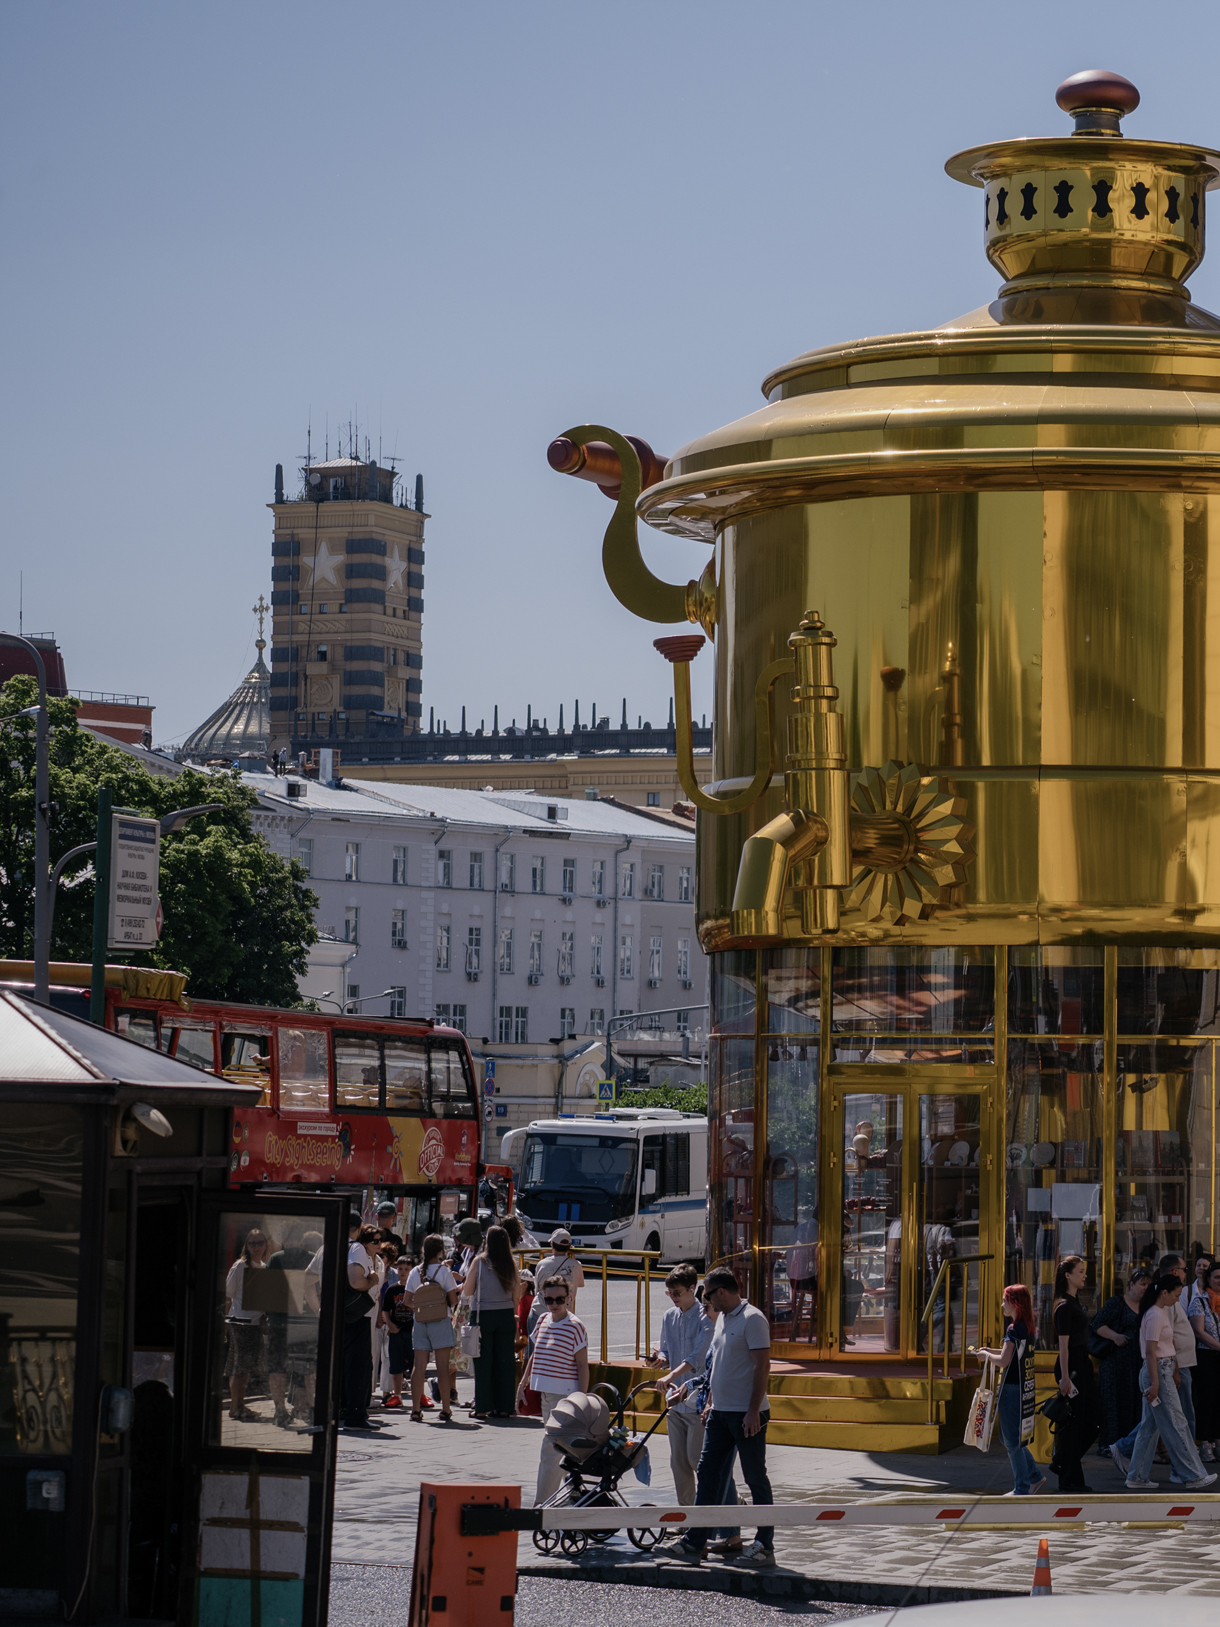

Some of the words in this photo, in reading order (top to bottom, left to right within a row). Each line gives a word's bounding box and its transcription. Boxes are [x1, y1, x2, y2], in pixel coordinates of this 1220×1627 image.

[264, 1131, 286, 1168] City
[284, 1134, 343, 1170] Sightseeing
[420, 1145, 444, 1168] OFFICIAL
